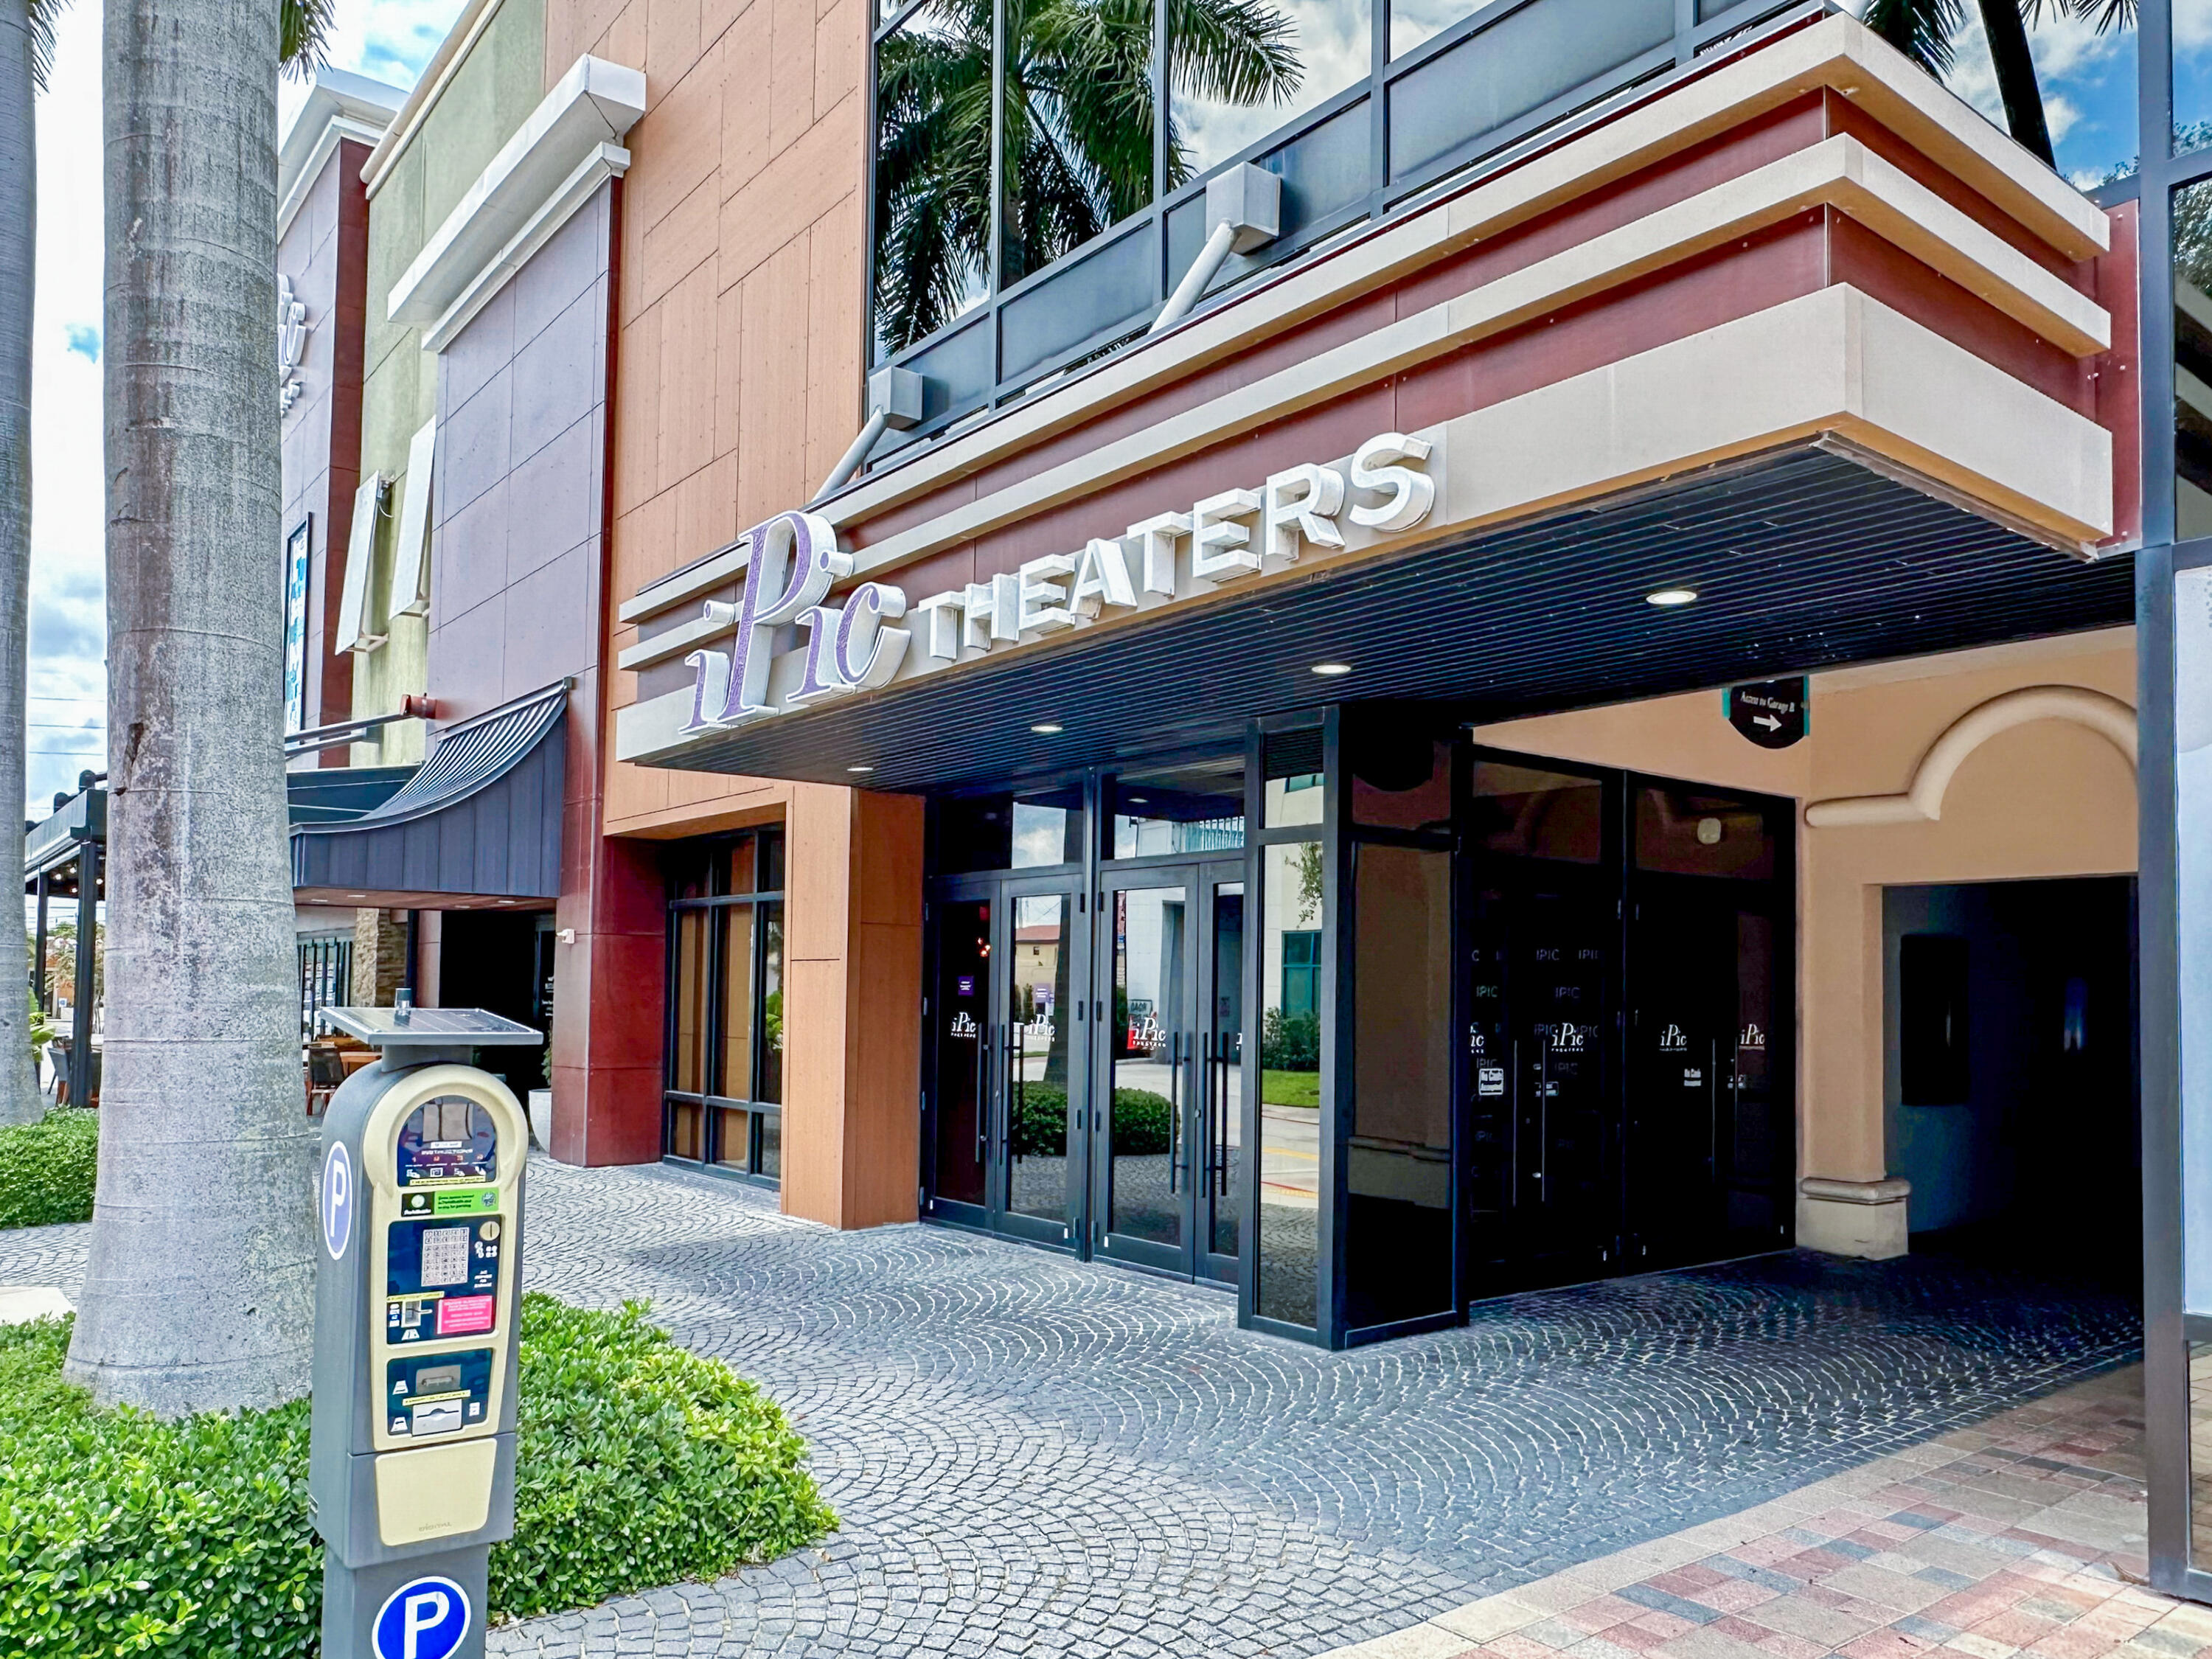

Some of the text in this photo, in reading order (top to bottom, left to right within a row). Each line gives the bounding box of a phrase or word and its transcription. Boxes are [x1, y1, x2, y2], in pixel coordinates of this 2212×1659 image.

[678, 432, 1436, 736] iPic THEATERS
[1476, 986, 1498, 998] IPIC
[951, 1012, 976, 1032] iPic
[1028, 1014, 1055, 1036] iPic
[1133, 1017, 1166, 1040] iPic
[1551, 1023, 1584, 1046] iPic
[1660, 1024, 1687, 1046] iPic
[1740, 1023, 1765, 1045] iPic
[330, 1160, 347, 1238] P
[403, 1591, 450, 1659] P
